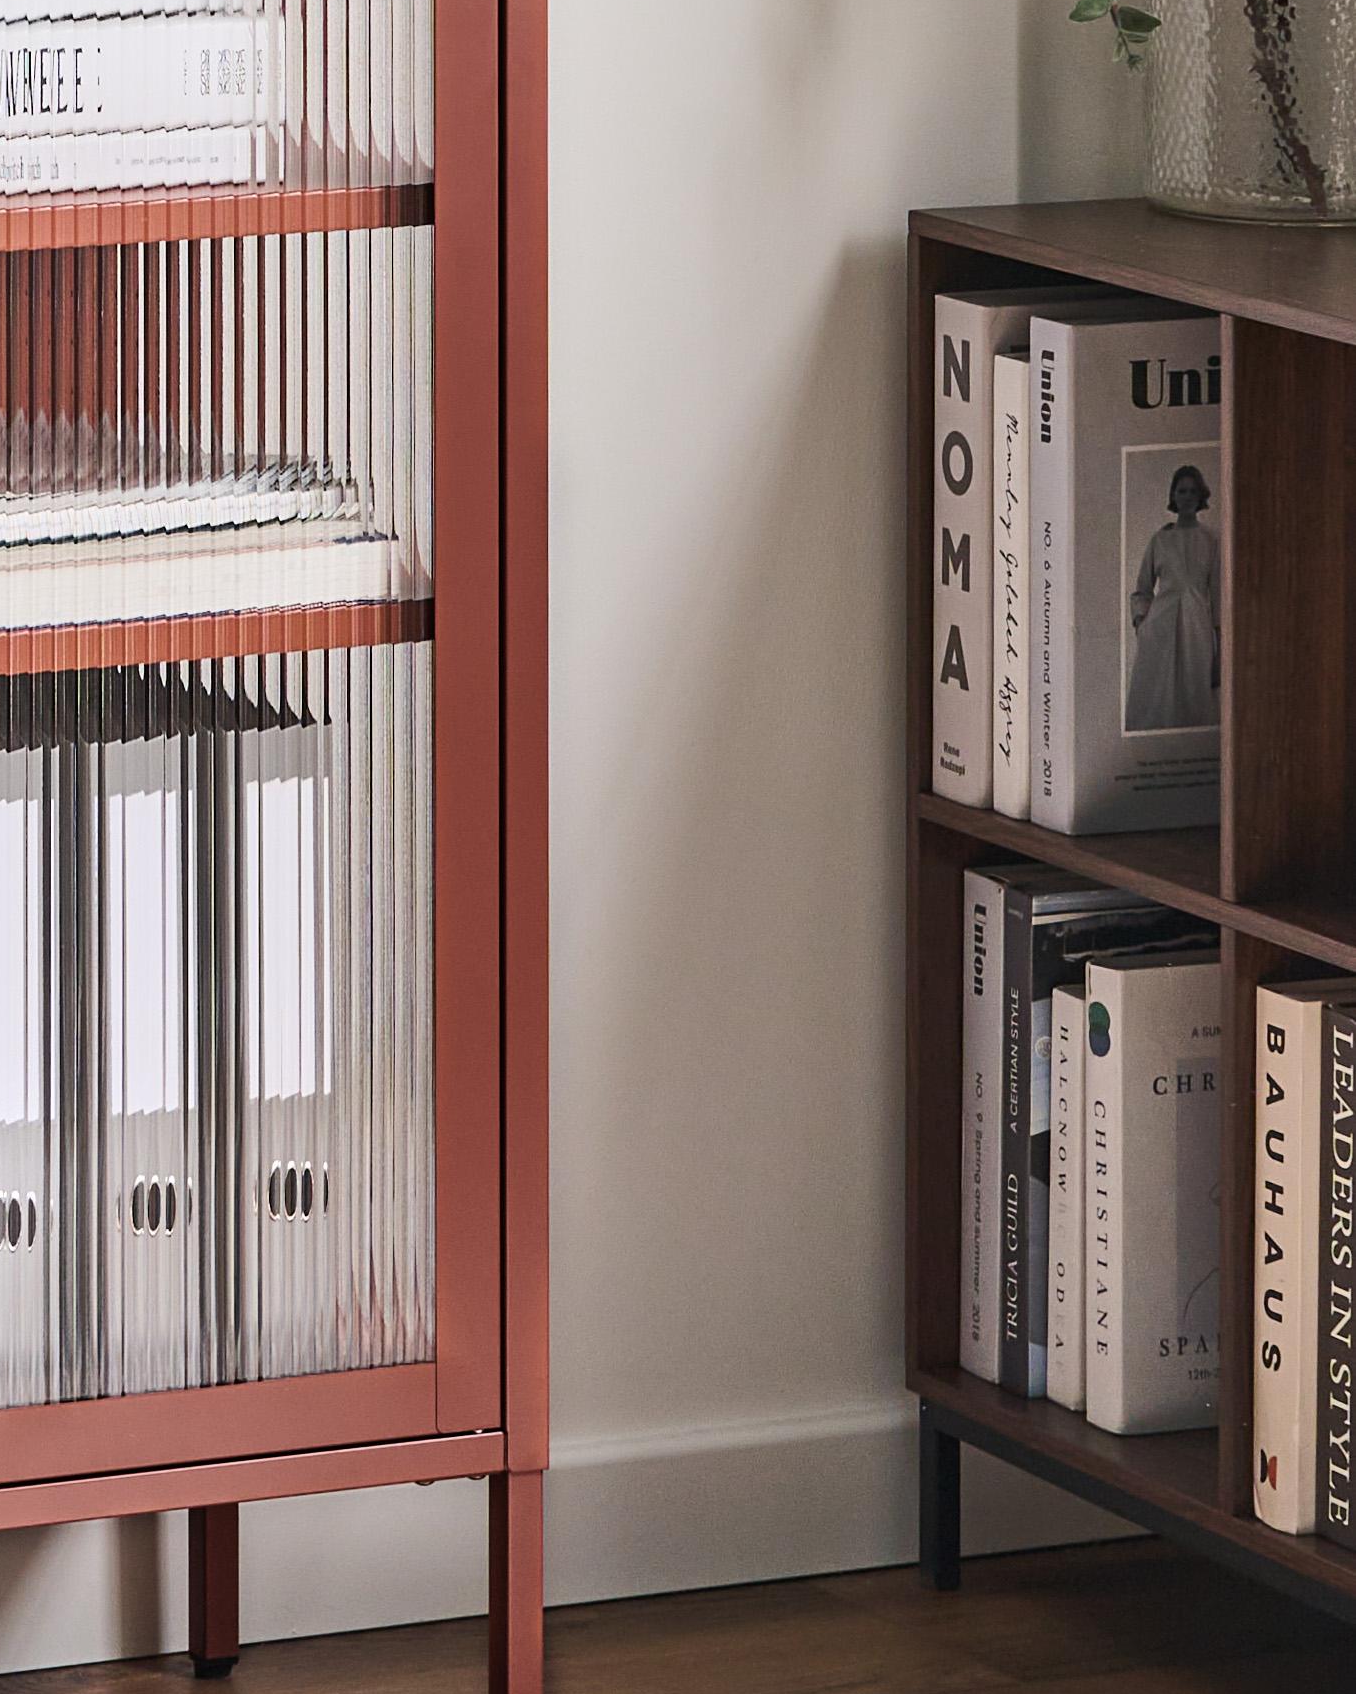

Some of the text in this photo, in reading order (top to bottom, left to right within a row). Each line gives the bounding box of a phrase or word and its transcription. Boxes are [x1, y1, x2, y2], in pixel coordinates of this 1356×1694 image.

[1041, 350, 1055, 444] Union
[940, 334, 974, 691] NOMA
[1044, 560, 1053, 571] 6
[1043, 578, 1053, 646] Autumn
[1043, 649, 1053, 684] and
[1043, 691, 1052, 751] Winter
[1043, 758, 1053, 798] 2018
[974, 904, 987, 997] Union
[1010, 987, 1019, 1039] STYLE
[1010, 1122, 1017, 1134] A
[1095, 1099, 1108, 1356] CHRISTIANE
[1262, 1023, 1285, 1372] BAUHAUS
[1006, 1173, 1018, 1341] TRICIA GUILD
[1328, 1025, 1354, 1526] LEADERS IN STYLE
[972, 1304, 981, 1343] 2018
